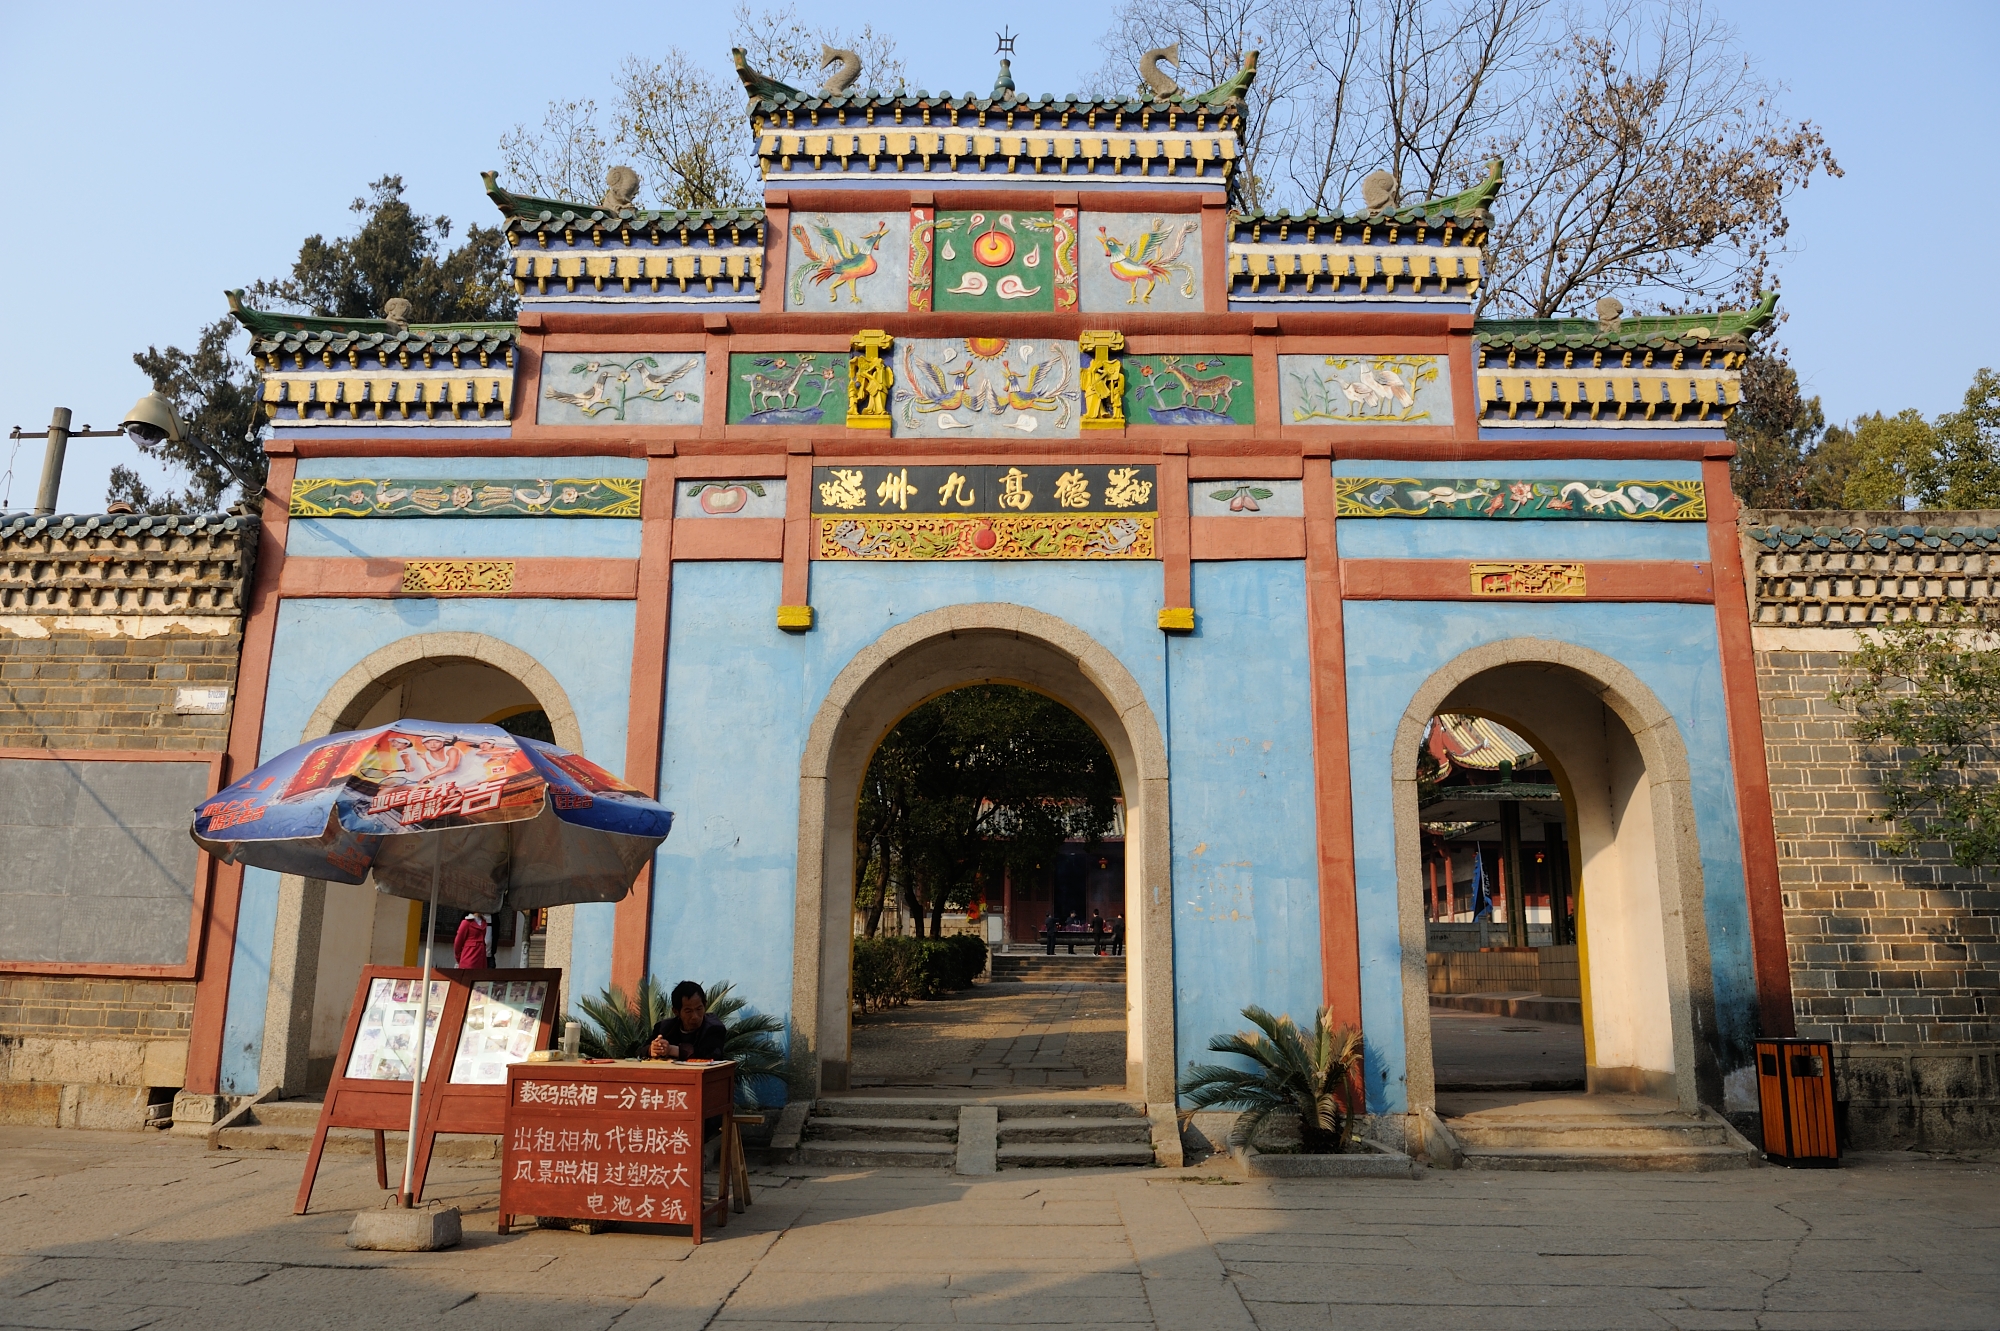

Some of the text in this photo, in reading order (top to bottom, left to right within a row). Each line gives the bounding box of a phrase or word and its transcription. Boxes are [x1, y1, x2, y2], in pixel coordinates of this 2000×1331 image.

[201, 797, 258, 818] 怕上火
[367, 781, 457, 814] 亚运有我
[208, 805, 267, 832] 喝王老吉
[520, 1081, 689, 1111] 数码照相 一分钟取
[513, 1125, 692, 1155] 出租相机 代售胶卷
[512, 1159, 691, 1189] 风景照相 过塑放大
